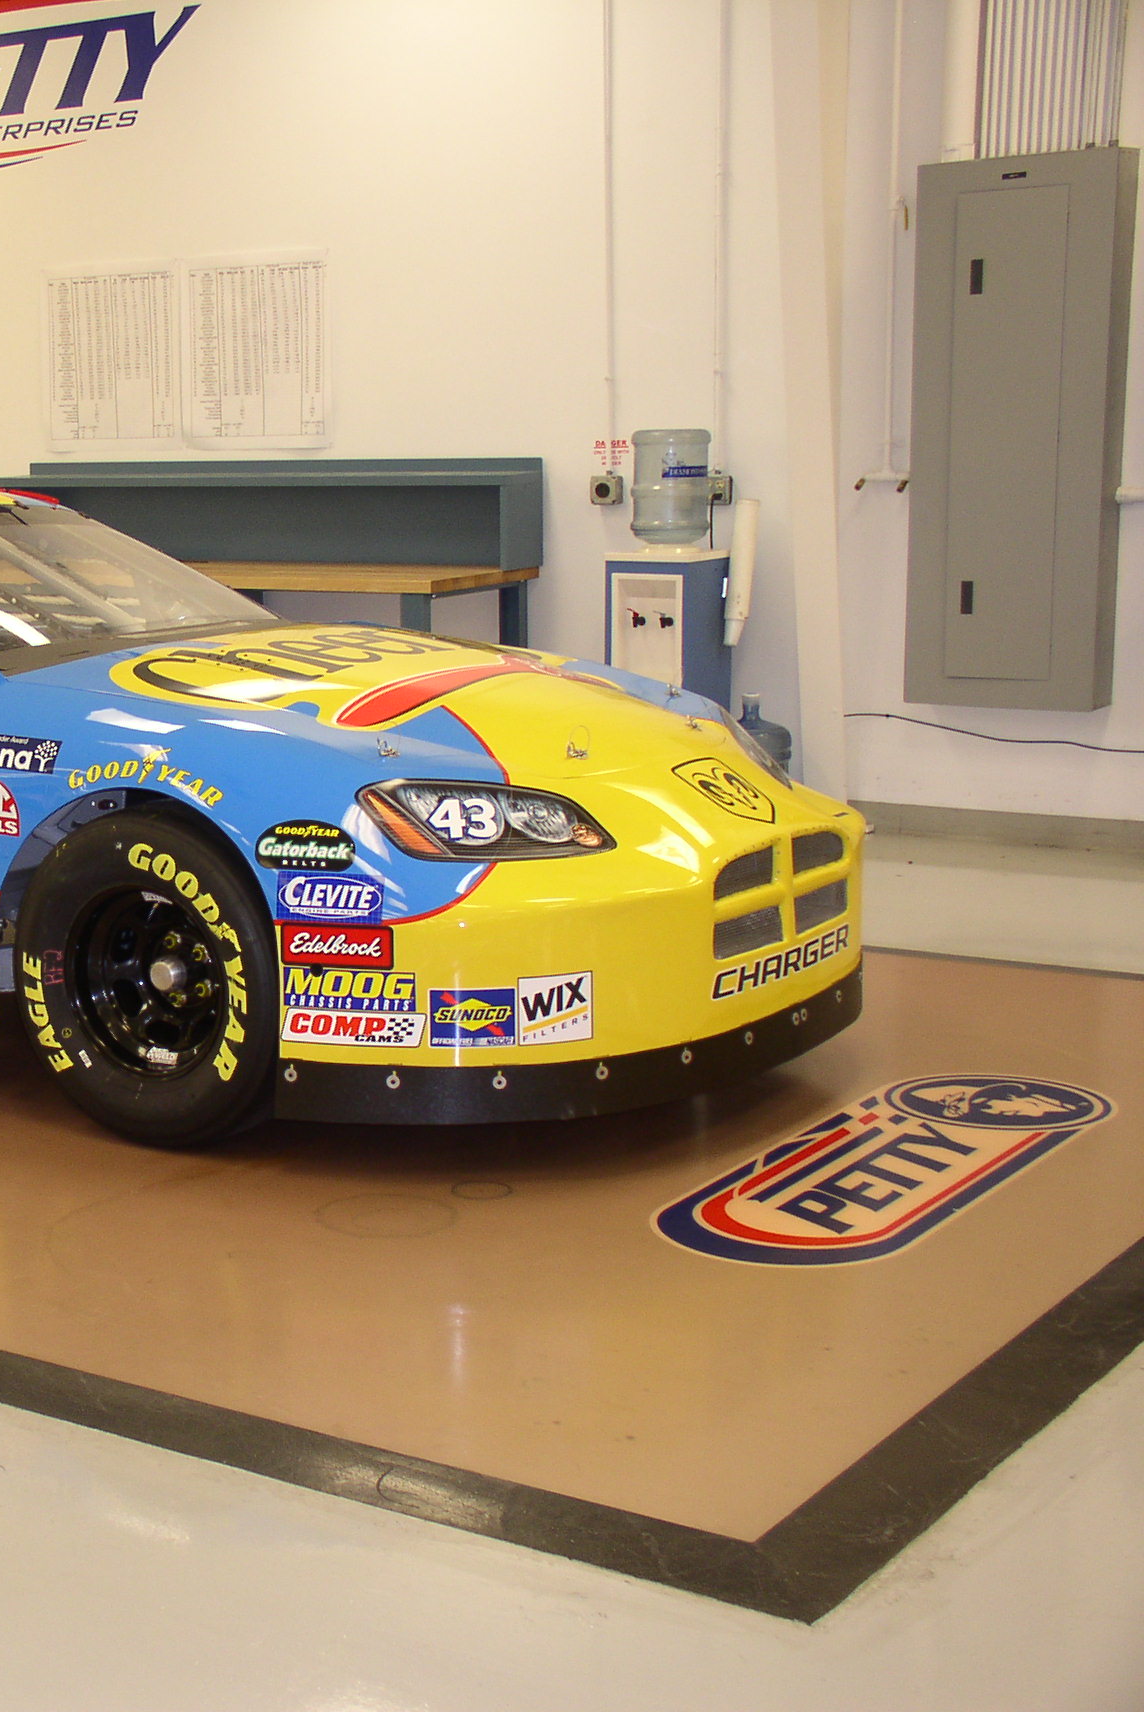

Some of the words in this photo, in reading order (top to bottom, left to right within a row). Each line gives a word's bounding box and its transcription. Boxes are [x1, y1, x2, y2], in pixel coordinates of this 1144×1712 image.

[595, 440, 627, 448] DAGER
[275, 825, 340, 837] GOODYEAR
[428, 797, 498, 841] 43
[258, 836, 351, 860] Gatorback
[285, 876, 375, 909] CLEVITE
[289, 932, 382, 958] Edelbrock
[712, 924, 849, 1000] CHARGER
[285, 968, 414, 1000] MOOG
[22, 952, 73, 1073] EAGLE
[289, 994, 352, 1009] CHASSIS
[362, 999, 412, 1012] PARTS
[521, 976, 587, 1022] WIX
[289, 1012, 387, 1037] COMP
[437, 1007, 508, 1022] SUNOCO
[354, 1034, 405, 1043] CAMS
[522, 1014, 589, 1043] FILTERS
[776, 1121, 978, 1235] PETTY
